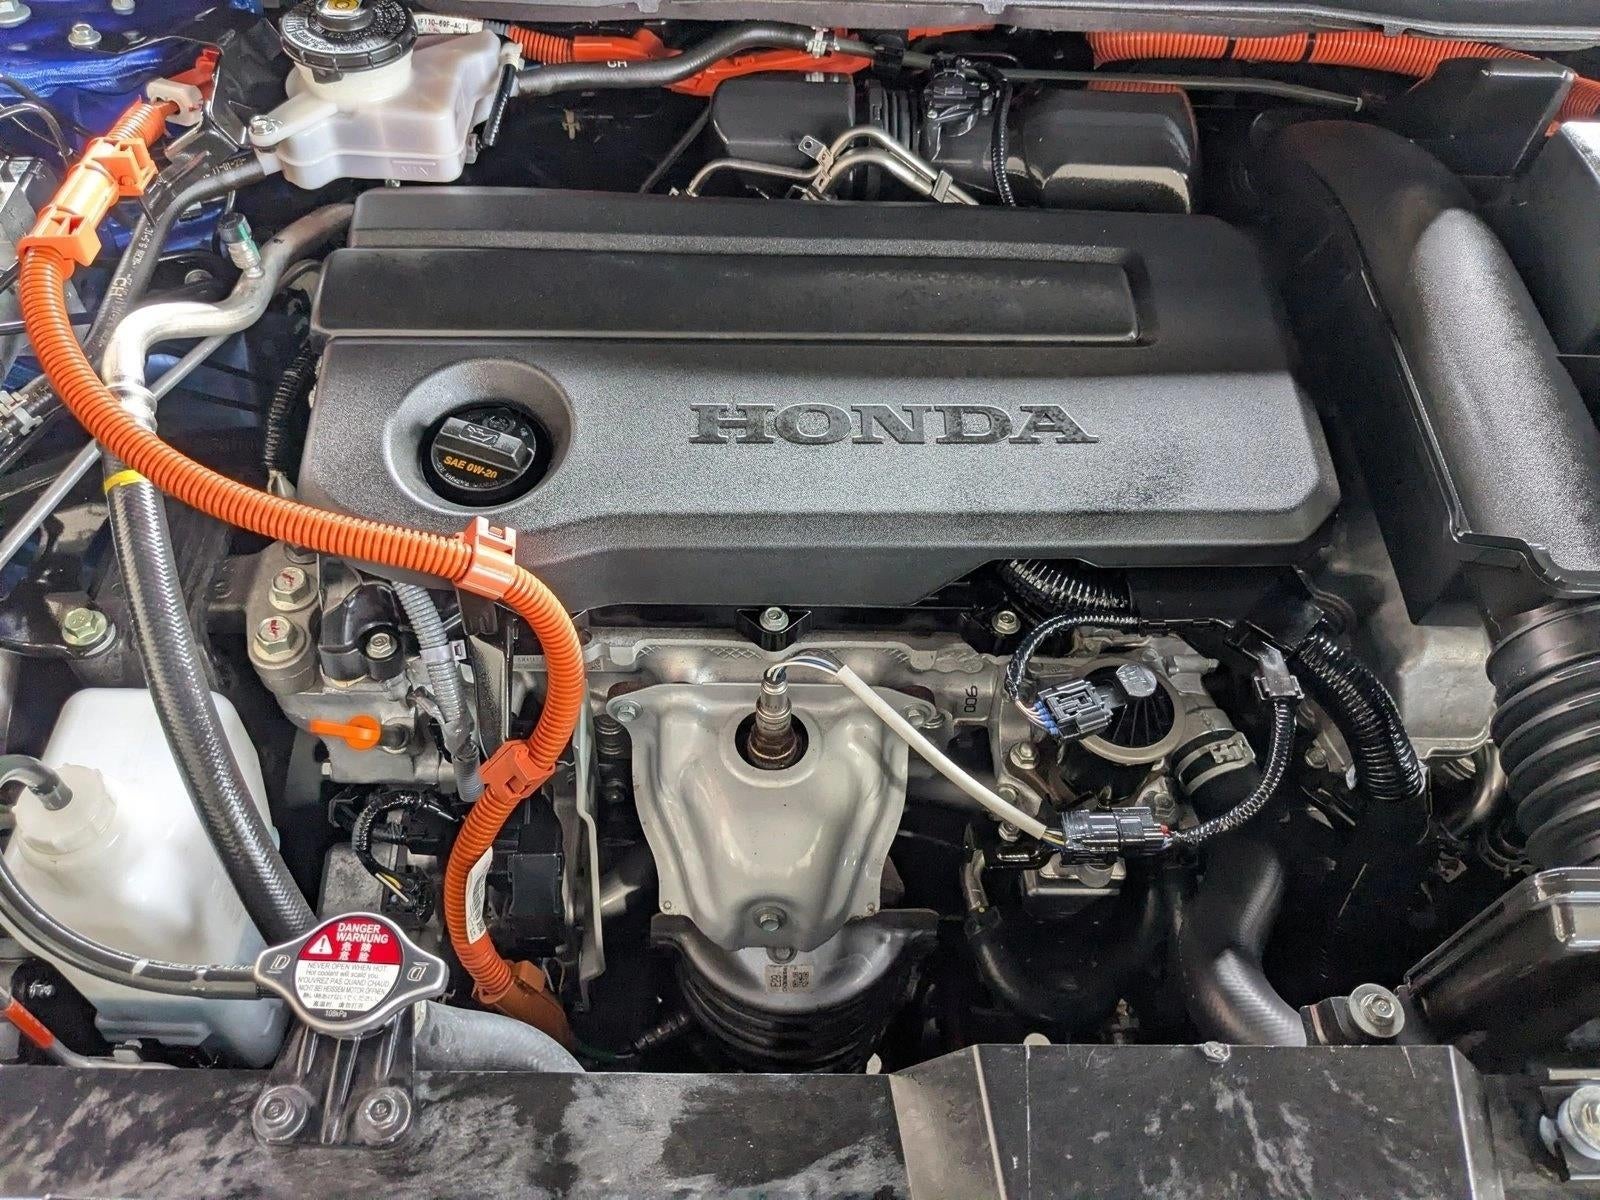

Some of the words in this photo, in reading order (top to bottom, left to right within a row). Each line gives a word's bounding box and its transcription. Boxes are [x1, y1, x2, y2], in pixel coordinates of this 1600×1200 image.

[689, 402, 1100, 444] HONDA
[443, 455, 467, 469] SAE
[466, 463, 498, 479] 0W-20
[337, 922, 381, 934] DANGER
[336, 932, 389, 944] WARNUNG
